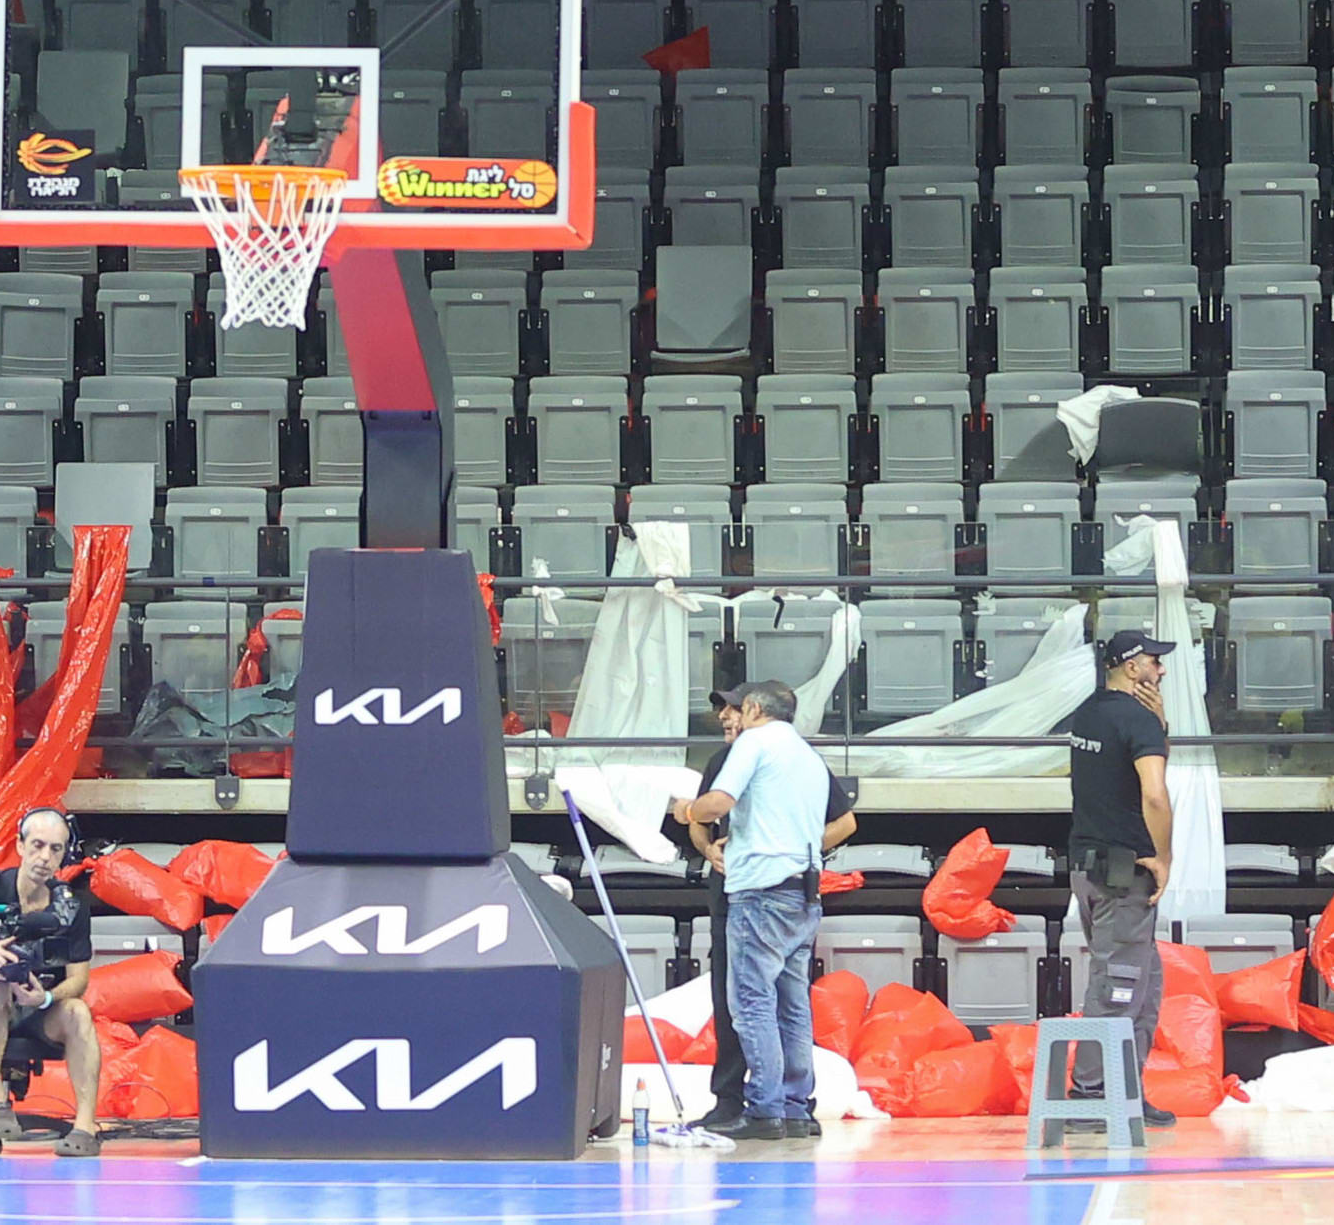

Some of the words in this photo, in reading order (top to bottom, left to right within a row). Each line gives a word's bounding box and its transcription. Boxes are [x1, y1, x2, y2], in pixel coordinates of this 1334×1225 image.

[398, 171, 506, 198] Winner
[508, 177, 536, 199] סל
[467, 164, 505, 183] ליגת
